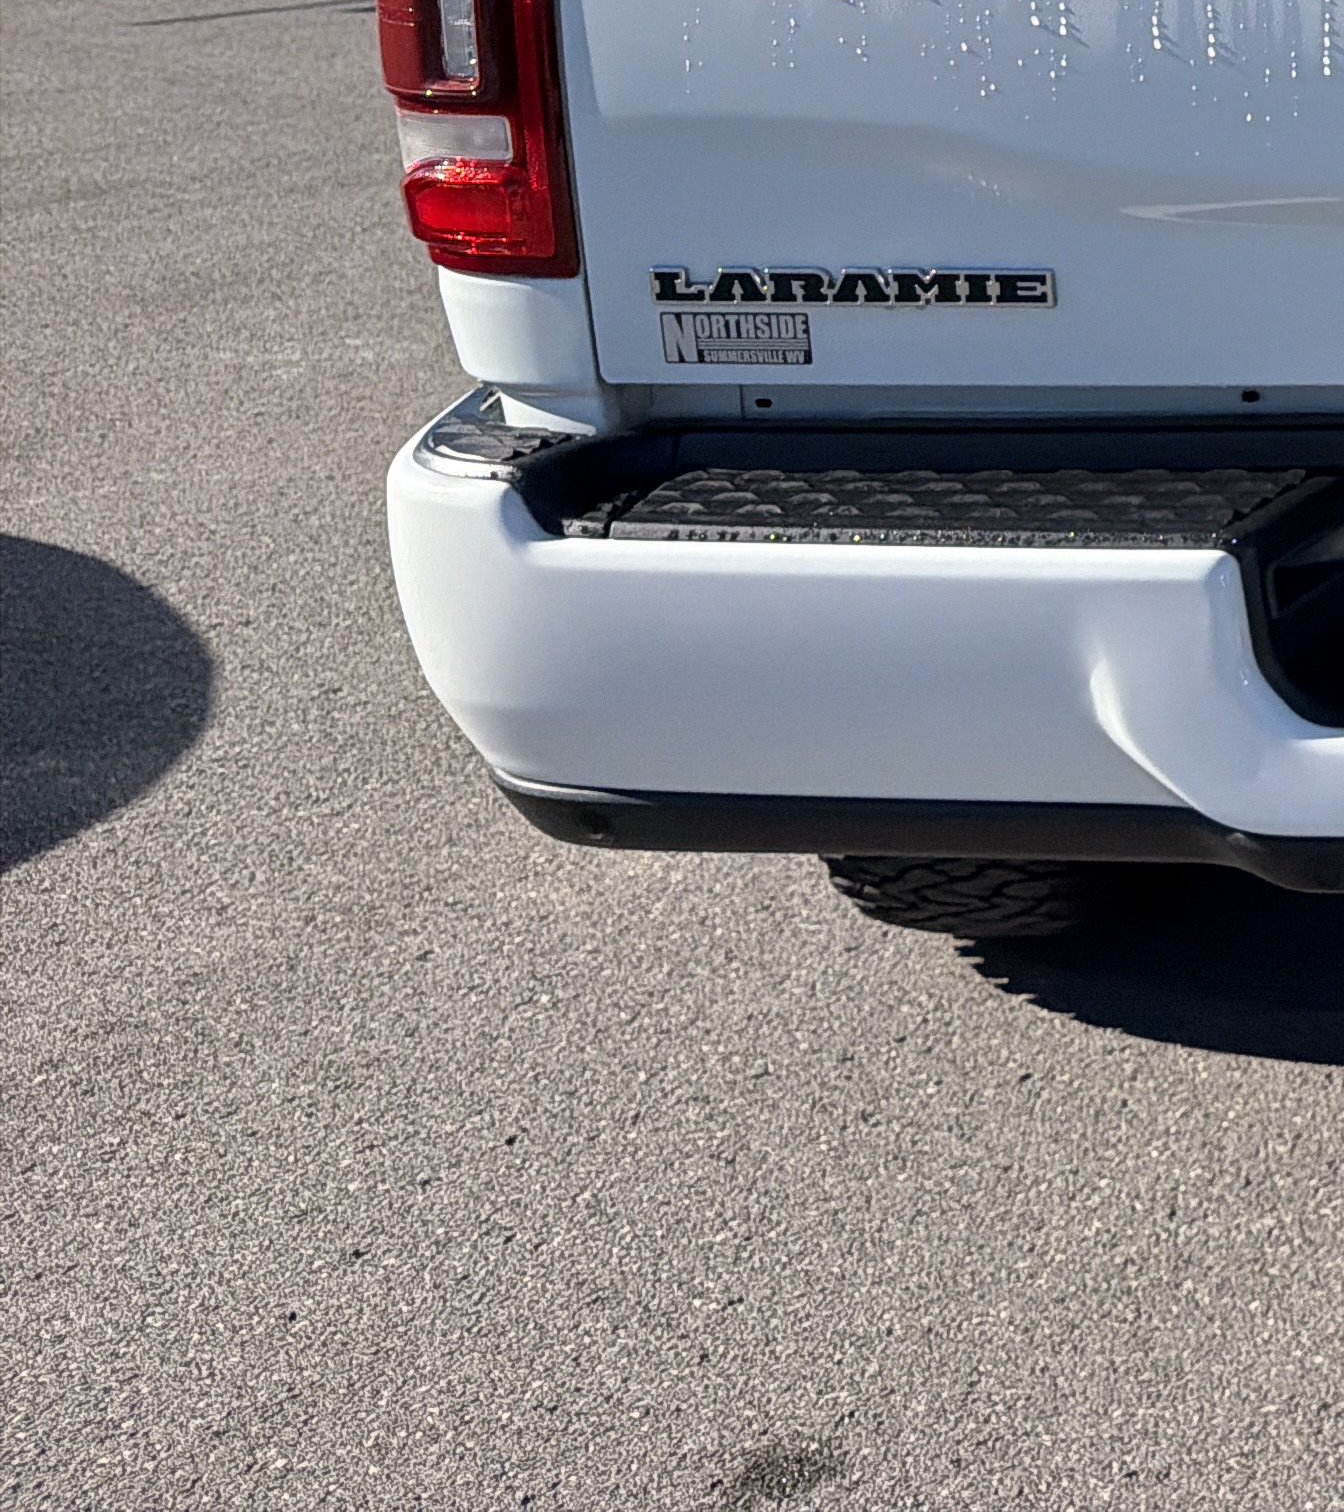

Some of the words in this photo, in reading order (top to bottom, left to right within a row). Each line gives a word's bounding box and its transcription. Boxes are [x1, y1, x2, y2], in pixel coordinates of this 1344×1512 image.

[650, 268, 1056, 307] LARAMIE
[661, 313, 808, 362] NORTHSIDE
[703, 349, 785, 363] SUMMERSVILLE
[785, 350, 806, 364] WV
